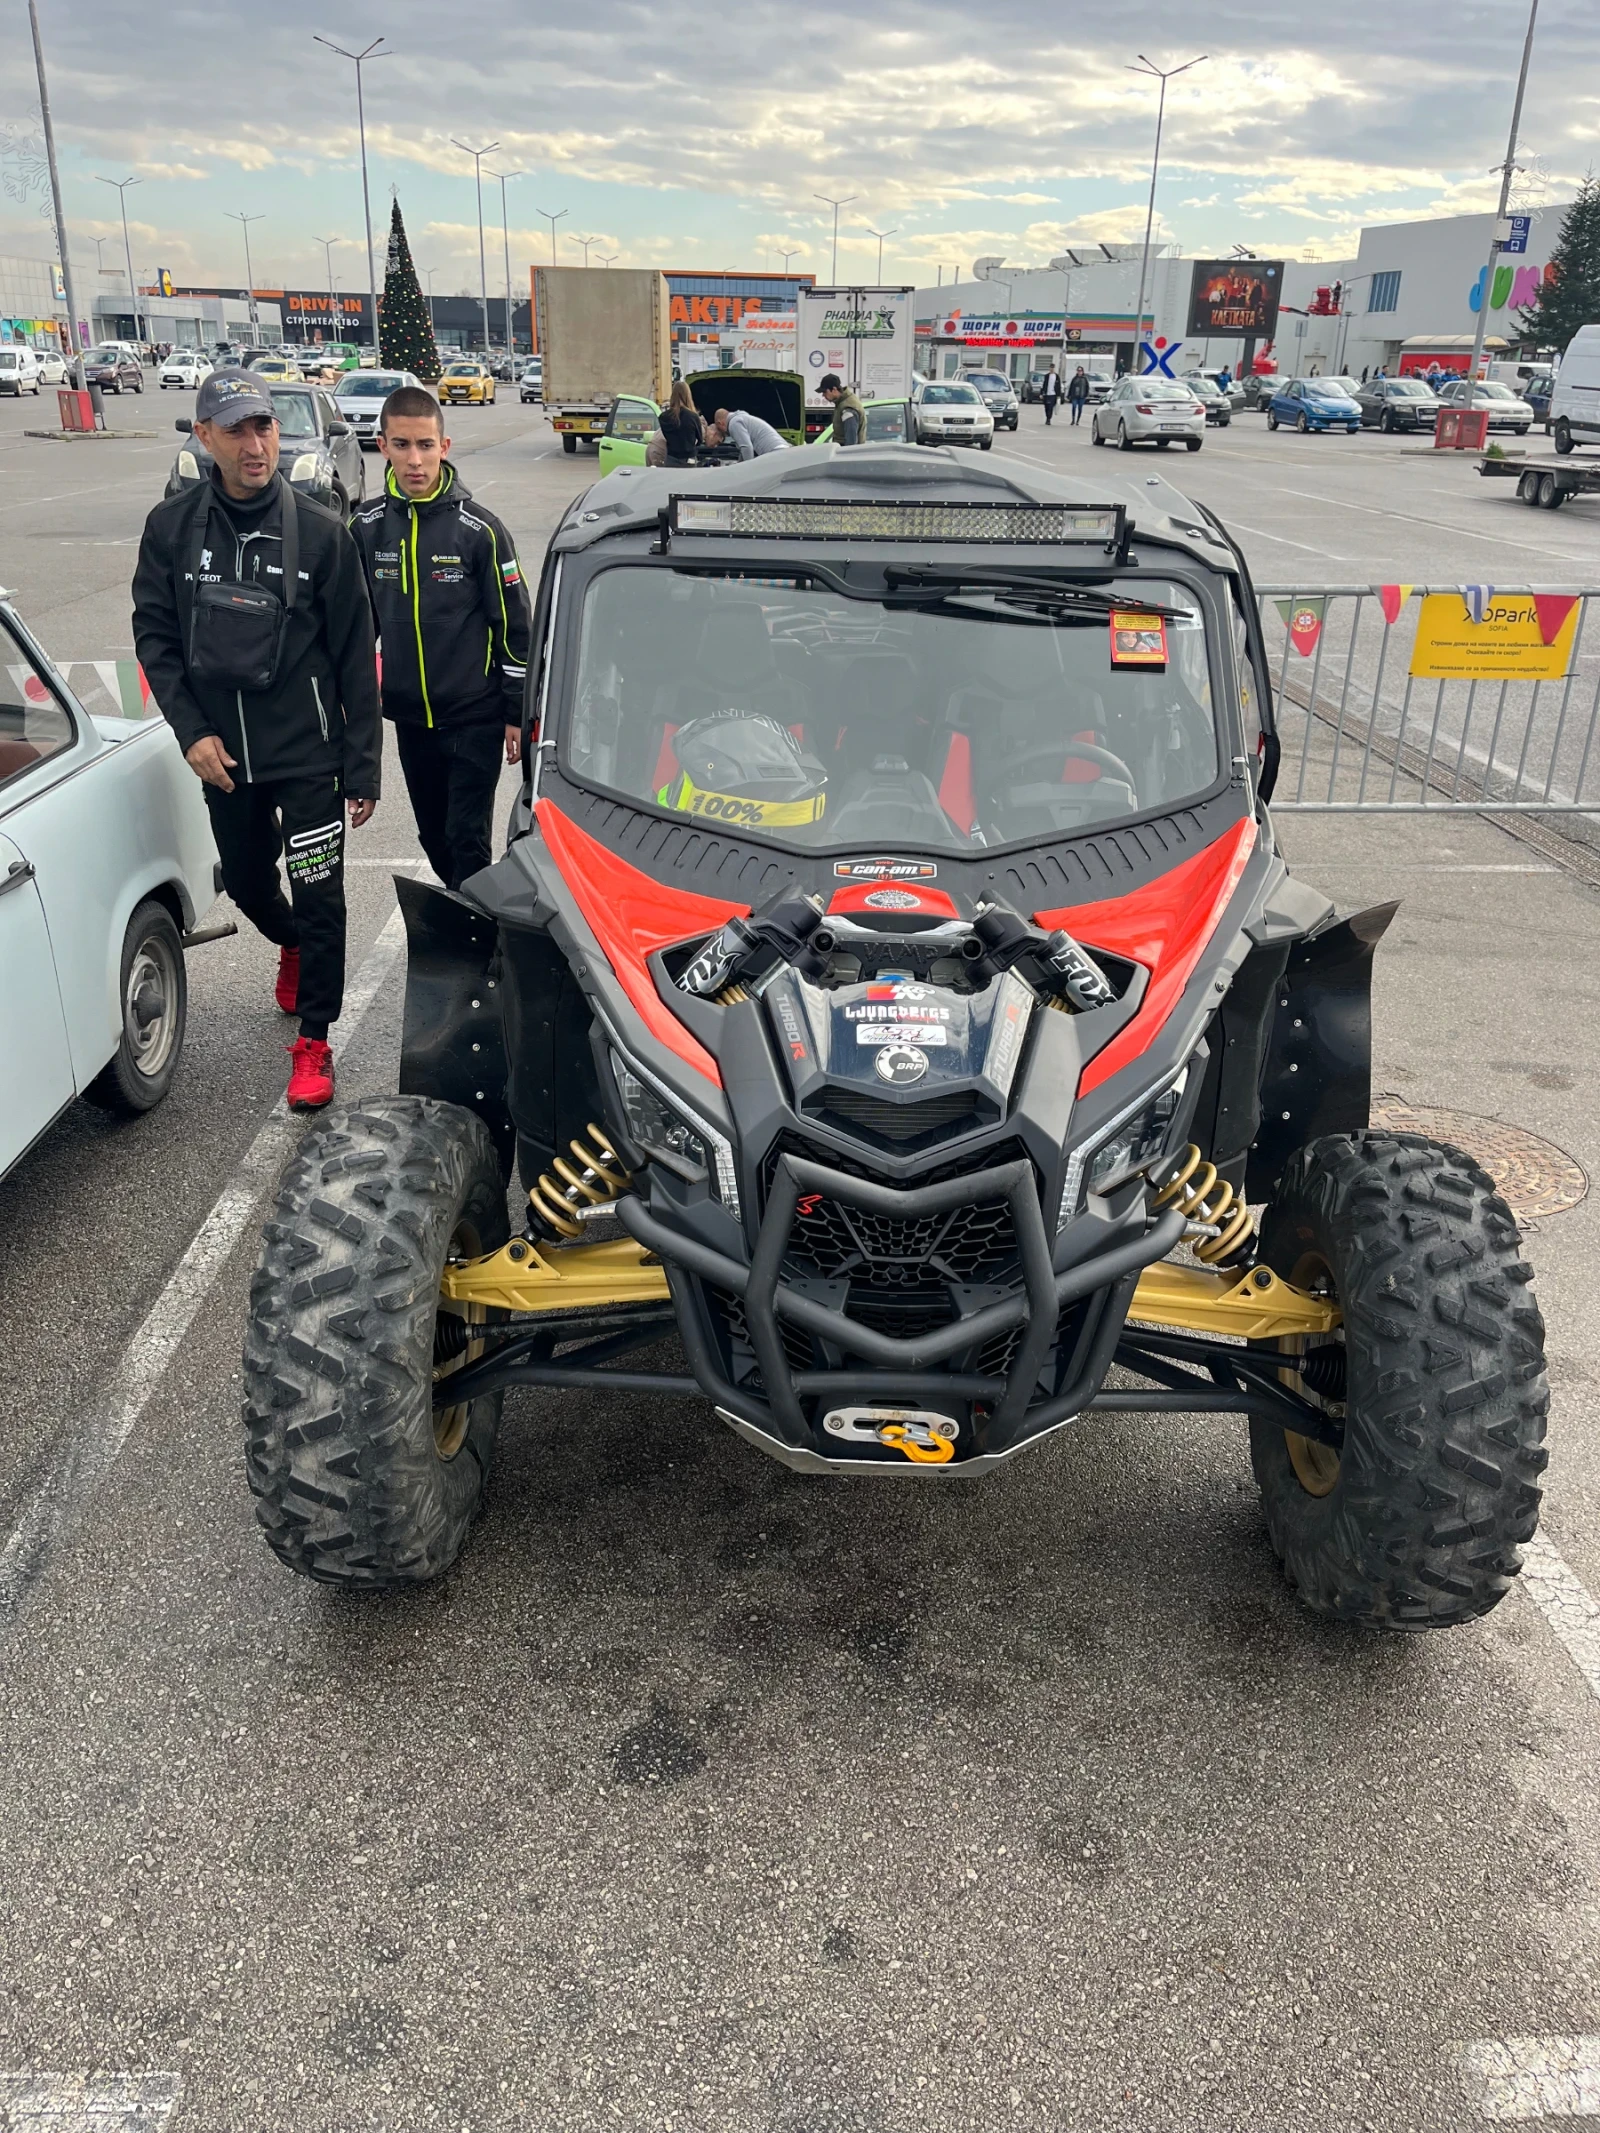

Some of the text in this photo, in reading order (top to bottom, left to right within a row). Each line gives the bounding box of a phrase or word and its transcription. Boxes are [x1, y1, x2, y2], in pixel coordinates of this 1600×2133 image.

[289, 297, 363, 312] DRIVE-IN
[671, 296, 762, 324] AKTIS
[824, 311, 872, 320] PHARMA
[1211, 310, 1256, 326] КЛЕТКАТА
[286, 316, 360, 327] СТРОИТЕЛСТВО
[821, 321, 868, 331] EXPRESS
[962, 321, 1062, 331] ЩОРИ ЩОРИ
[185, 573, 222, 582] PGEOT
[309, 846, 323, 856] THE
[296, 859, 308, 869] THE
[308, 854, 326, 866] PAST
[299, 867, 313, 877] SEE
[318, 855, 340, 870] BETTER
[304, 869, 331, 884] FUTUER
[896, 1062, 923, 1071] BRP
